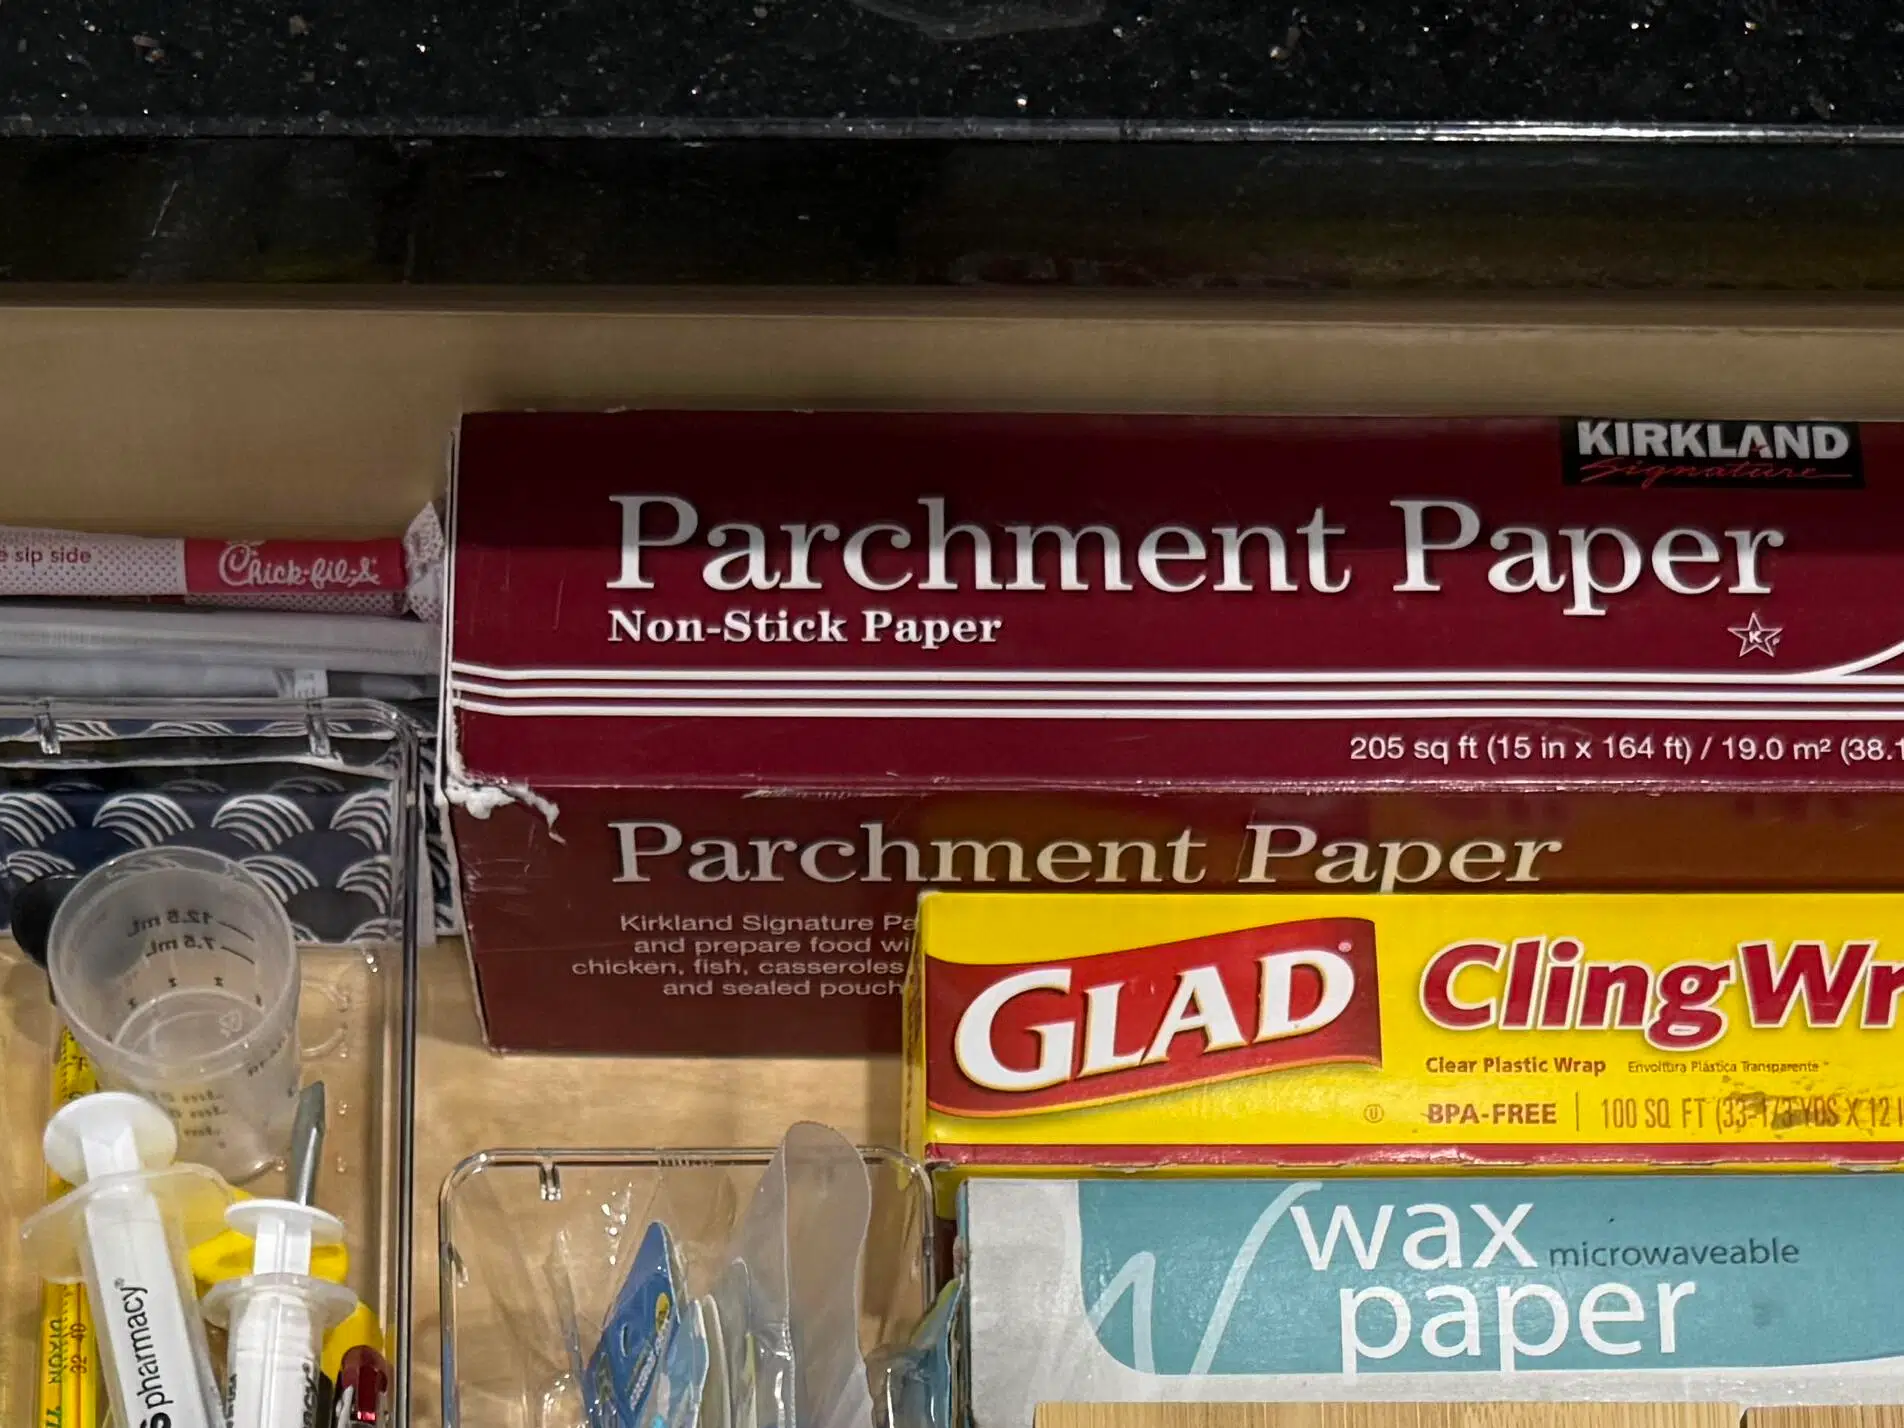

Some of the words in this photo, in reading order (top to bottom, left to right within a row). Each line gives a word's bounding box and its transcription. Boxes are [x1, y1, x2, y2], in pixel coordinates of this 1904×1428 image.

[1577, 421, 1851, 460] KIRKLAND
[1579, 458, 1853, 490] Signature
[14, 546, 43, 570] sip
[49, 546, 93, 565] side
[606, 493, 1352, 594] Parchment
[1390, 499, 1786, 617] Paper
[607, 609, 848, 643] Non-Stick
[861, 611, 1003, 650] Paper
[1349, 737, 1405, 761] 205
[1413, 740, 1450, 765] sq
[1456, 736, 1480, 761] ft
[1485, 735, 1532, 764] (15
[1540, 737, 1567, 760] in
[1575, 742, 1593, 760] x
[1602, 738, 1654, 761] 164
[1661, 735, 1695, 764] ft)
[1721, 738, 1784, 762] 19.0
[607, 820, 1208, 885] Parchment
[1237, 823, 1563, 893] Paper
[620, 913, 734, 933] Kirkland
[742, 913, 874, 936] Signature
[634, 936, 686, 954] and
[696, 938, 802, 958] prepare
[810, 936, 872, 954] food
[572, 958, 685, 978] chicken,
[693, 957, 749, 978] fish,
[759, 958, 905, 976] casseroles
[663, 979, 714, 997] and
[722, 979, 811, 997] sealed
[955, 947, 1356, 1092] GLAD
[1425, 1057, 1478, 1074] Clear
[1483, 1057, 1549, 1074] Plastic
[1553, 1057, 1607, 1077] Wrap
[1427, 1103, 1558, 1126] BPA-FREE
[1601, 1098, 1637, 1129] 100
[1644, 1098, 1672, 1129] SQ
[1682, 1097, 1707, 1128] FT
[1845, 1097, 1860, 1128] X
[1870, 1097, 1892, 1128] 12
[1290, 1202, 1538, 1272] wax
[1549, 1238, 1800, 1268] microwaveable
[1338, 1279, 1696, 1375] paper
